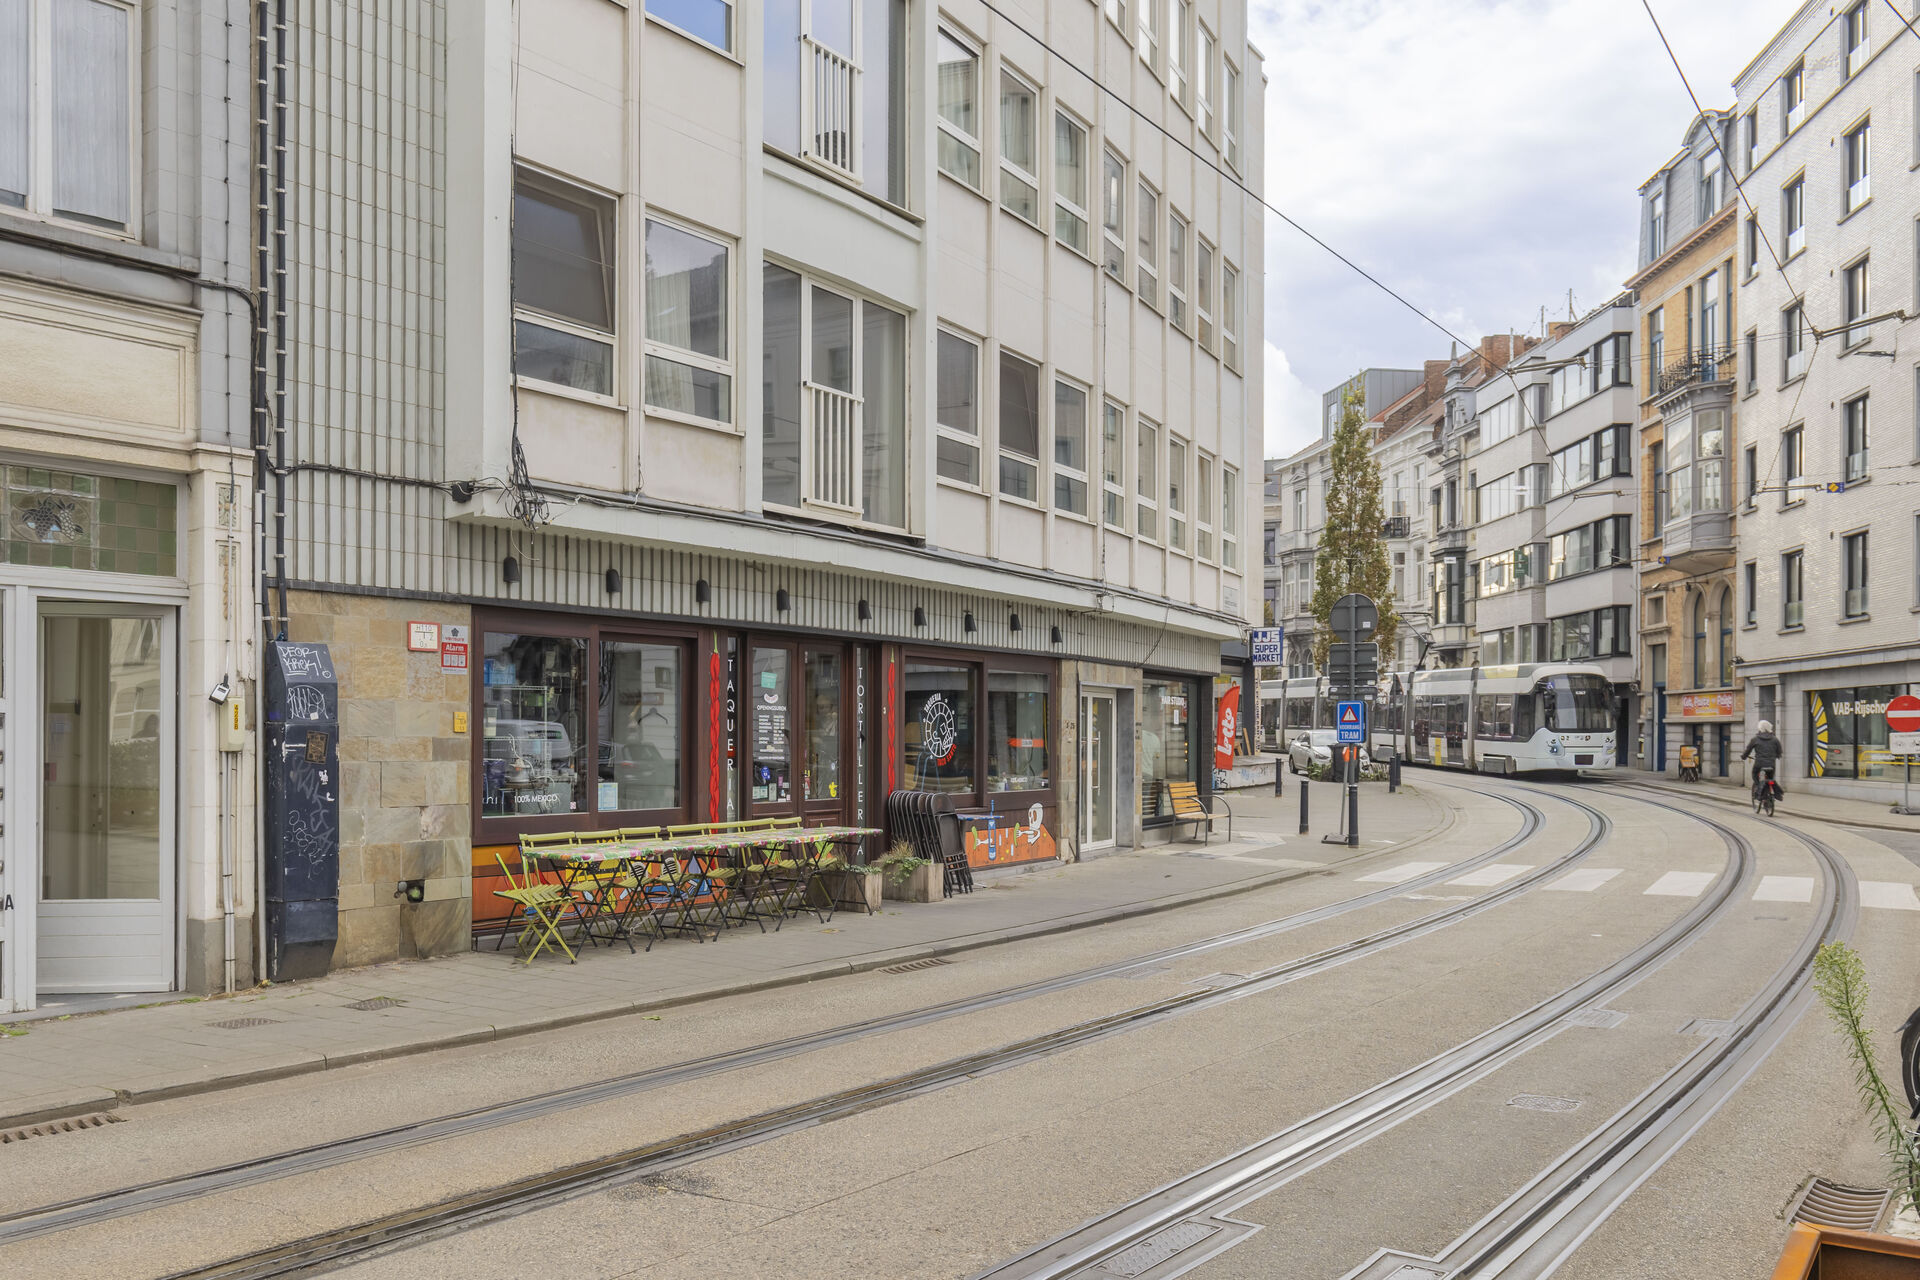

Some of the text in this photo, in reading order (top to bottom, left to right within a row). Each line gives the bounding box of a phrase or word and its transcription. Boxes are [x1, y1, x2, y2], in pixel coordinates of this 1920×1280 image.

[1253, 631, 1280, 643] JJS
[1254, 644, 1278, 654] SUPER
[1253, 654, 1280, 662] MARKET
[924, 692, 942, 713] TAQUERIA
[727, 659, 735, 810] TAQUERIA
[1340, 731, 1359, 740] TRAM
[856, 667, 864, 856] TORTILLERA
[514, 795, 531, 804] 100%
